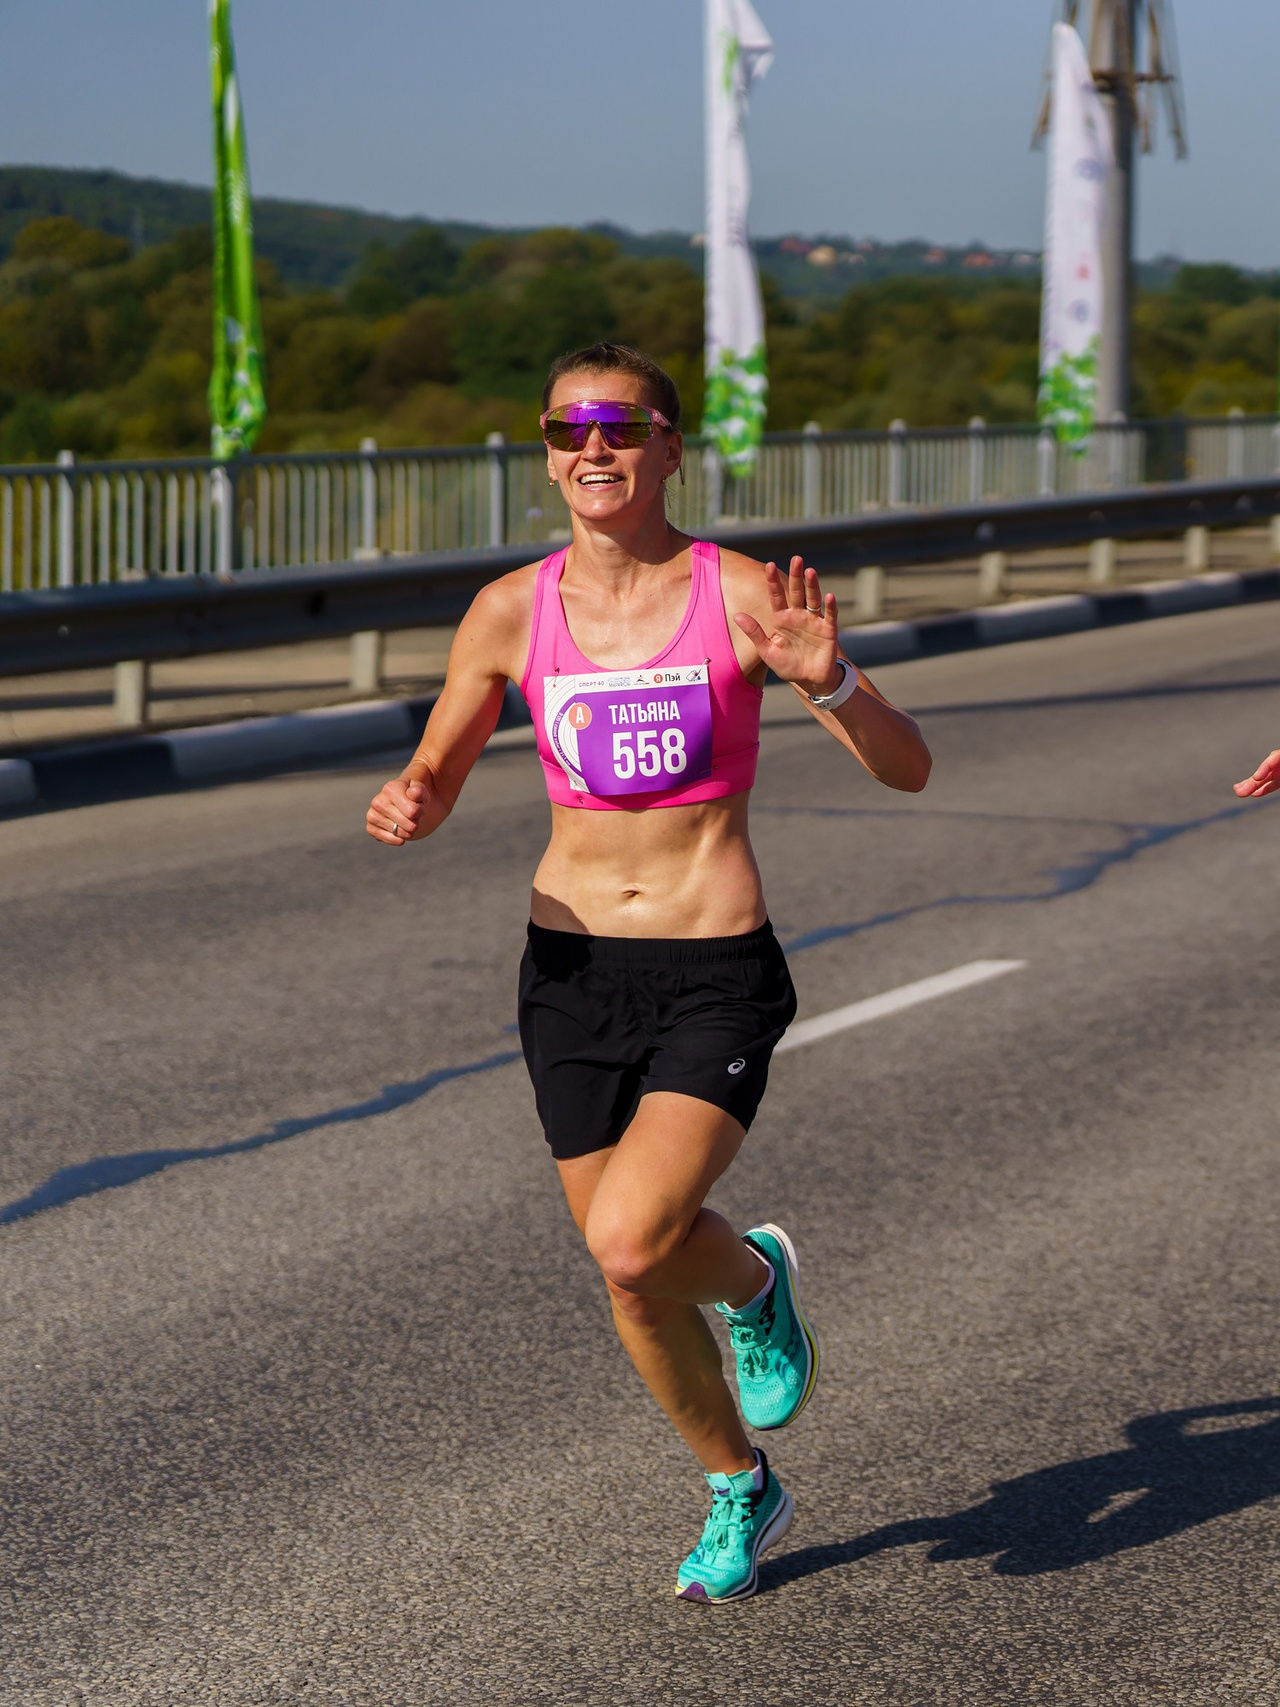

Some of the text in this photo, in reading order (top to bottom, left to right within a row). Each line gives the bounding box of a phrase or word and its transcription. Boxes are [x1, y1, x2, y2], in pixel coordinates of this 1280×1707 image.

[665, 673, 681, 682] Пэй
[608, 700, 681, 725] ТАТЬЯНА
[612, 727, 687, 780] 558
